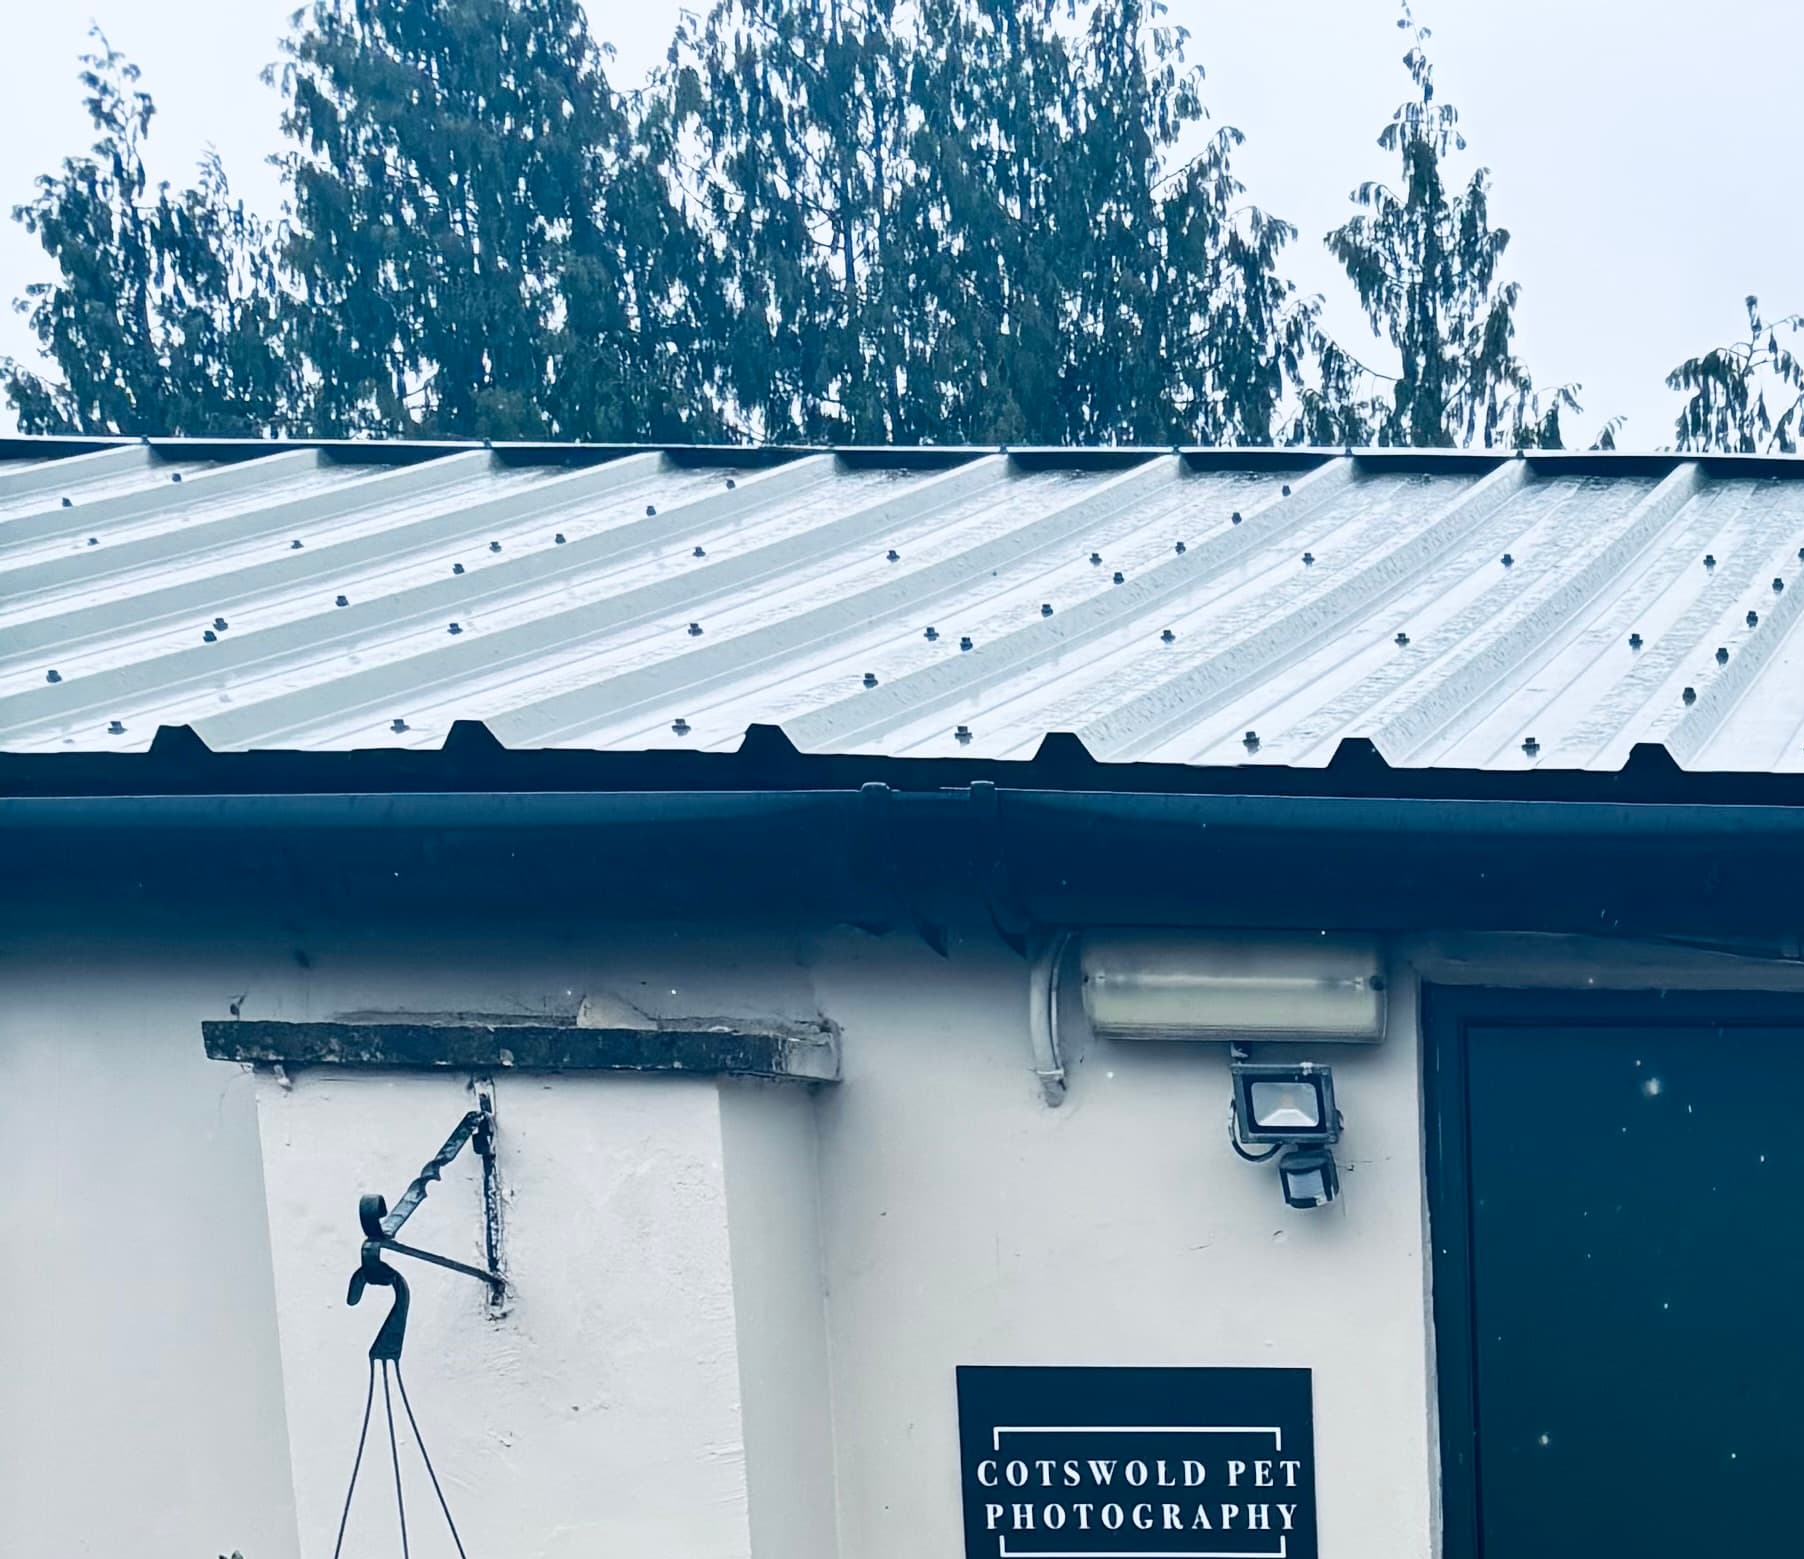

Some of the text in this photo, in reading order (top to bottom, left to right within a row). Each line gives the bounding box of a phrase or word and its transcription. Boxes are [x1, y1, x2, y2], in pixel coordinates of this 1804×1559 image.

[976, 1460, 1301, 1487] COTSWOLD PET
[985, 1503, 1298, 1530] PHOTOGRAPHY
